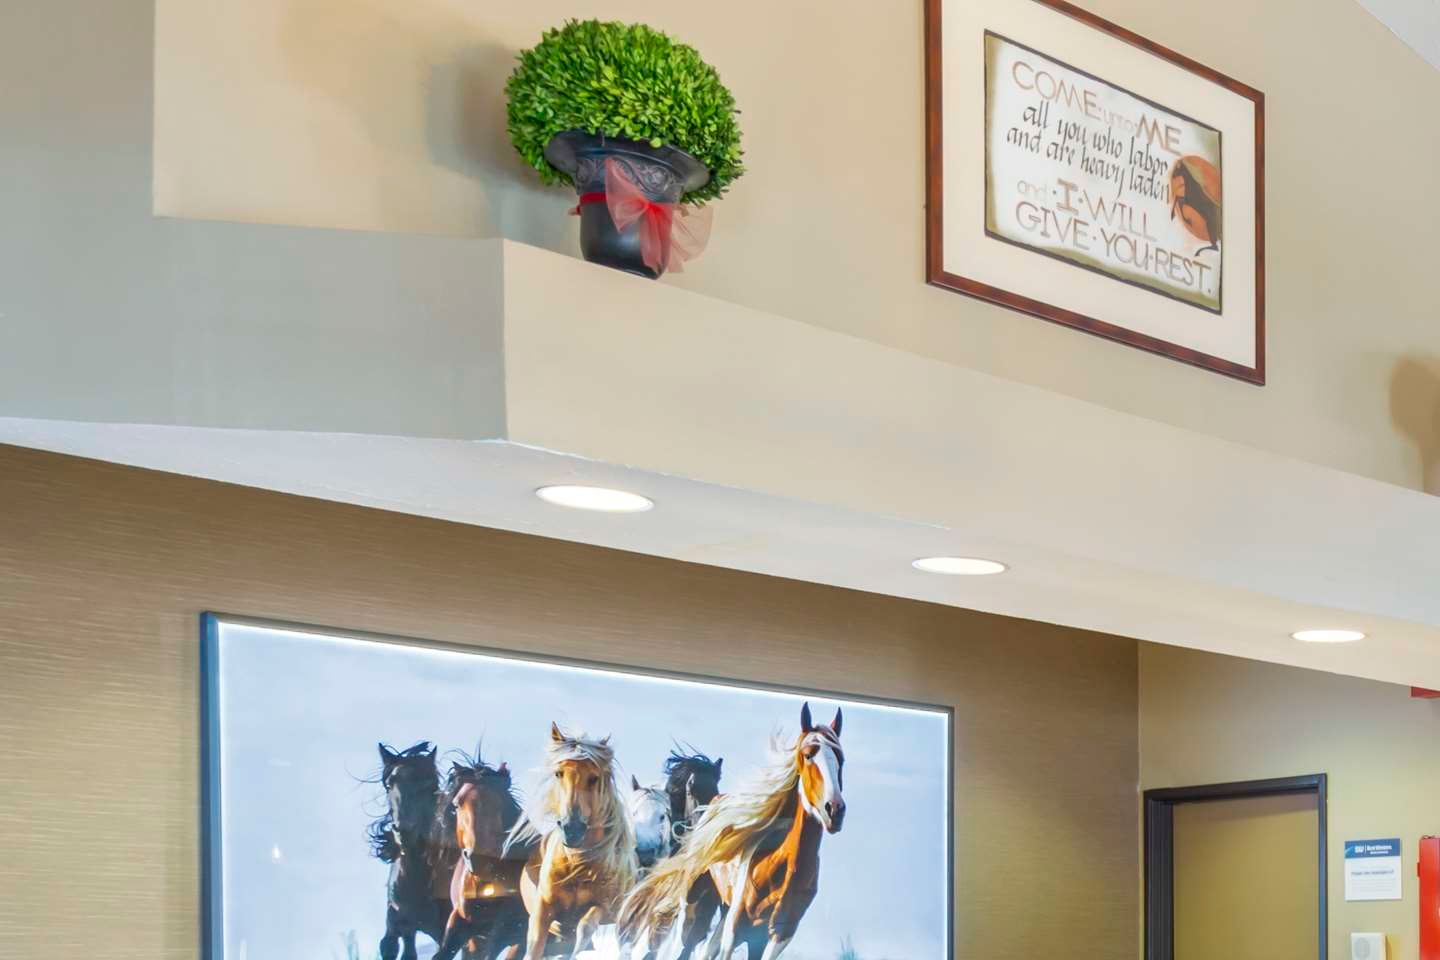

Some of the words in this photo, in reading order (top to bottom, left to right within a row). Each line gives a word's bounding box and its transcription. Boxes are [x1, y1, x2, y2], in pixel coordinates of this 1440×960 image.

[1012, 61, 1101, 121] COME
[1136, 113, 1183, 156] ME
[1023, 100, 1049, 128] all
[1057, 119, 1088, 145] you
[1093, 126, 1123, 158] who
[1129, 136, 1168, 175] labor
[1007, 126, 1041, 153] and
[1047, 139, 1075, 165] are
[1081, 146, 1125, 198] heavy
[1129, 165, 1169, 204] laden
[1016, 201, 1090, 250] GIVE
[1100, 227, 1149, 270] YOU
[1056, 178, 1079, 215] I
[1083, 190, 1157, 242] WILL
